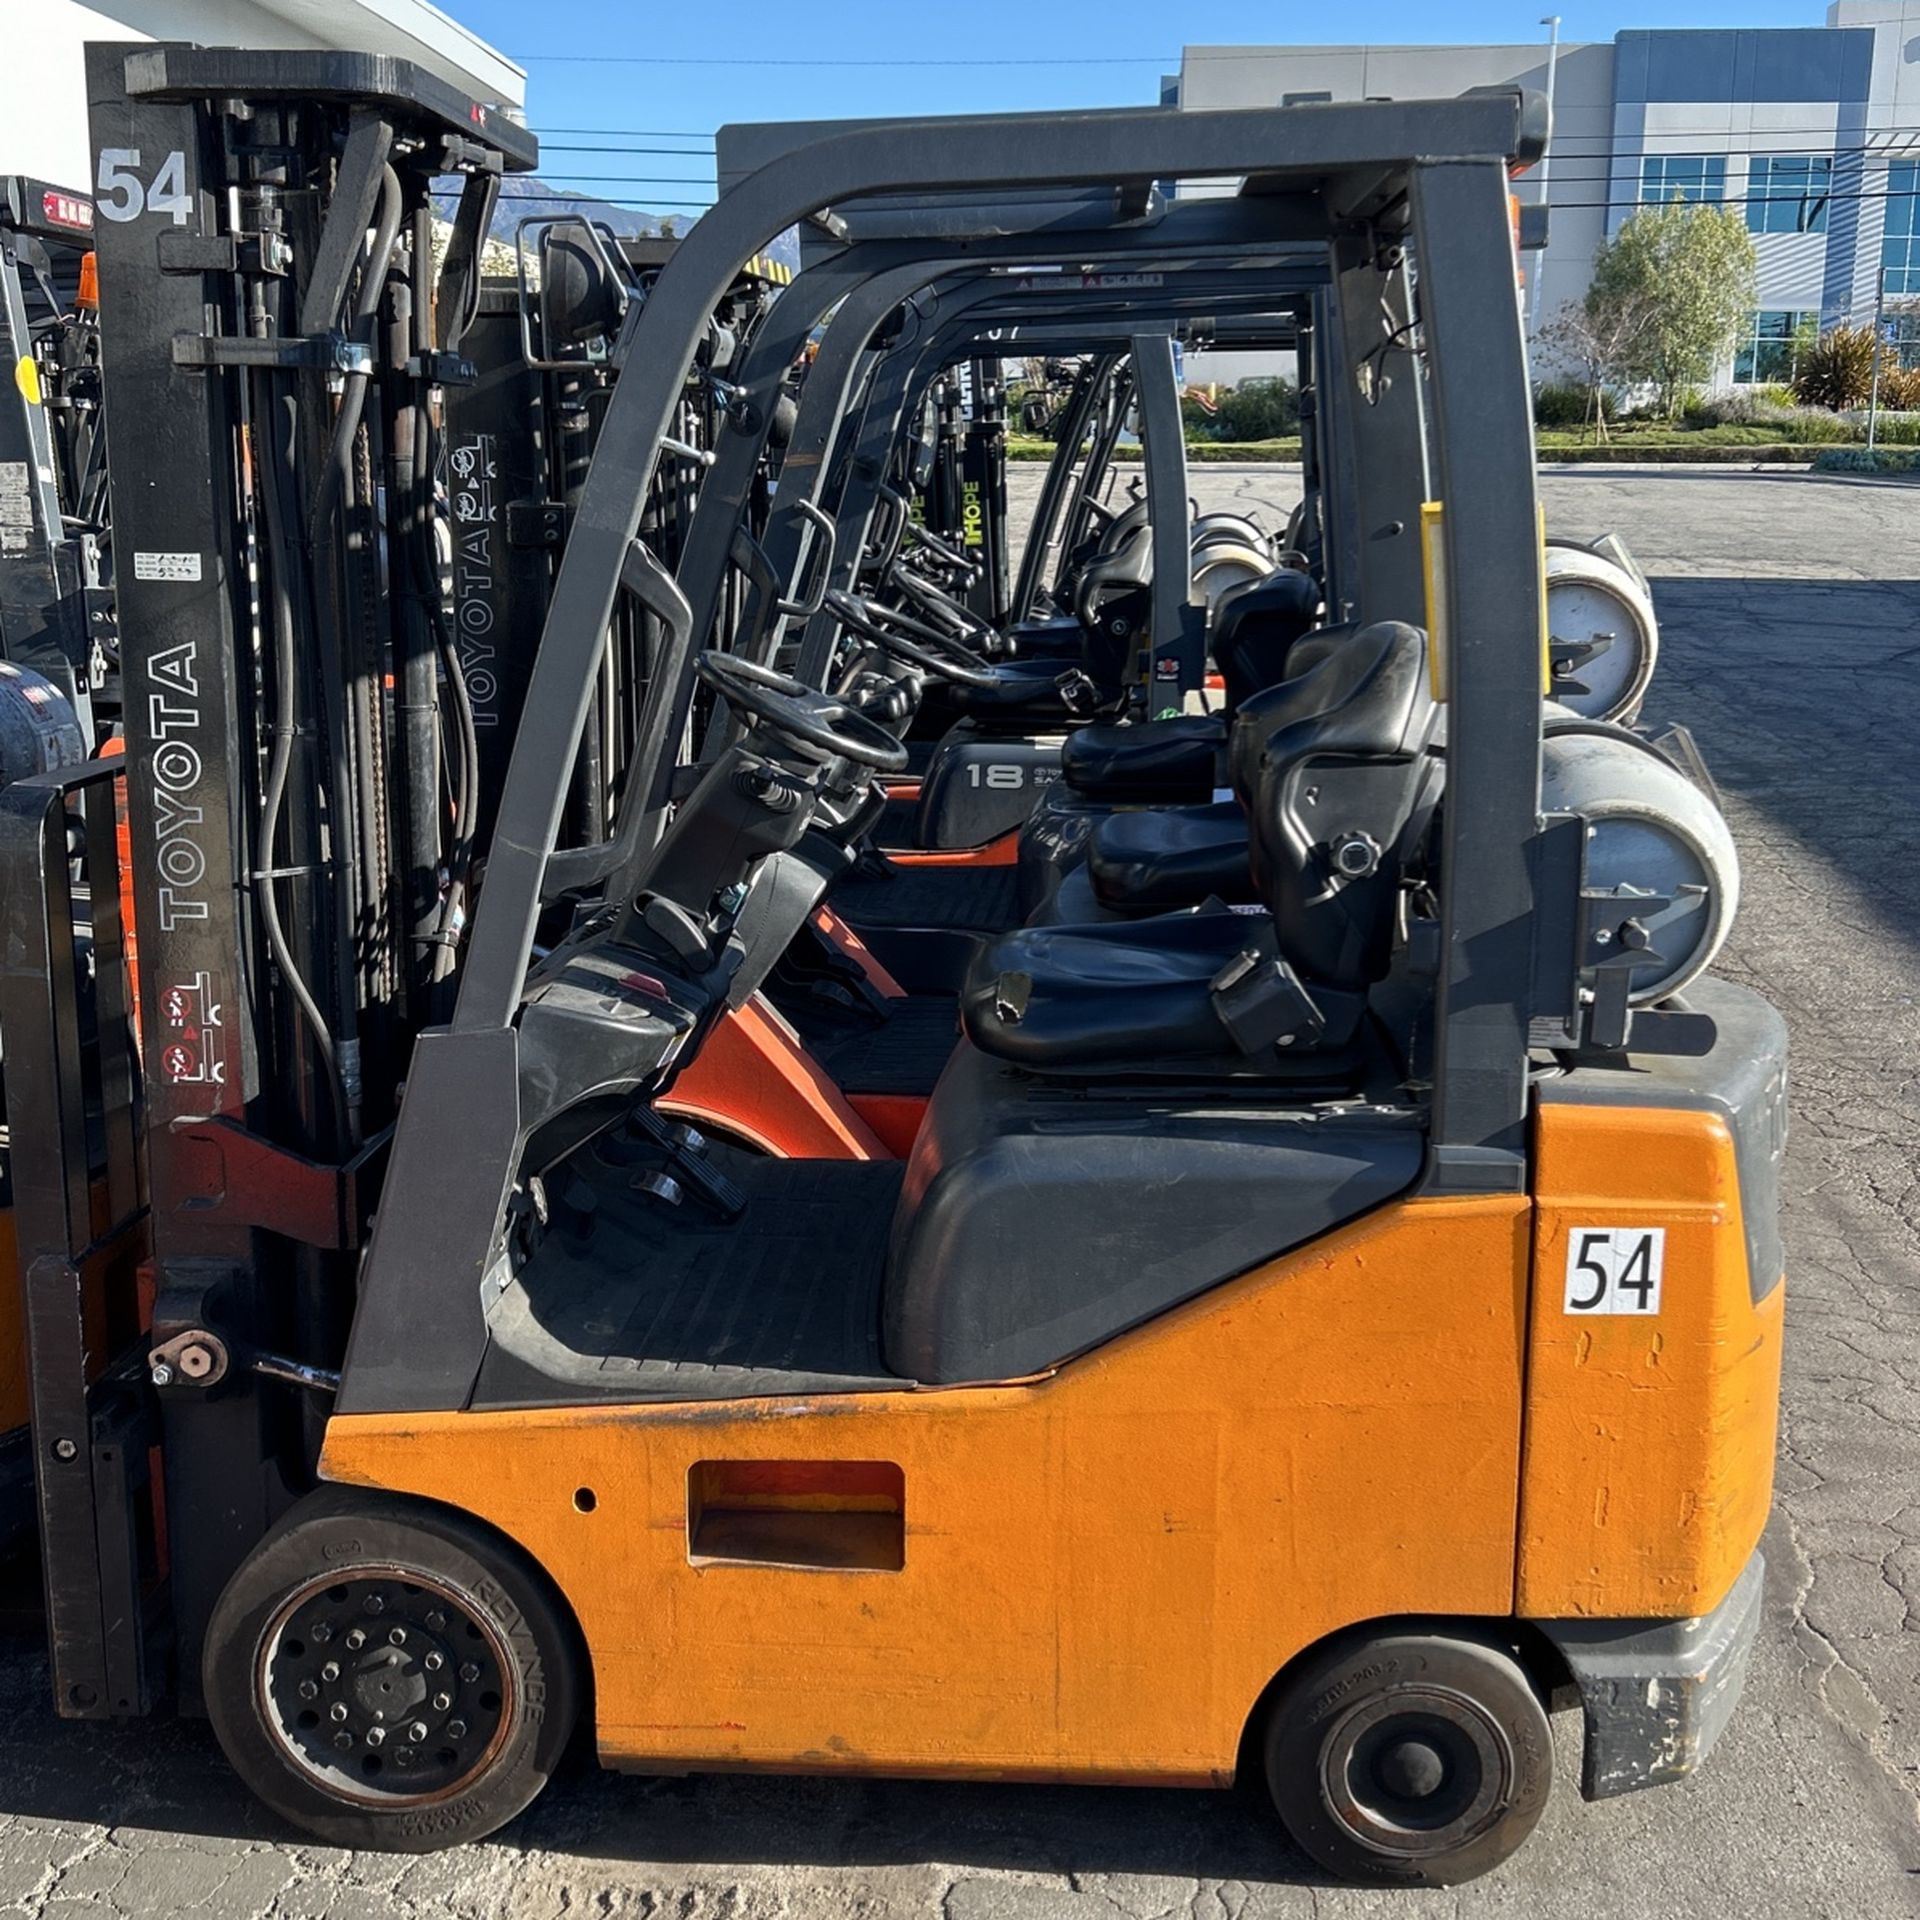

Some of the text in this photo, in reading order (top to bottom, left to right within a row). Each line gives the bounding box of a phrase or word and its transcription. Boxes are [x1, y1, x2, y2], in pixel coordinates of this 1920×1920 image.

[96, 148, 194, 225] 54
[459, 527, 499, 726] TOYOTA
[148, 640, 208, 931] TOYOTA
[966, 763, 1024, 789] 18
[1569, 1234, 1654, 1310] 54
